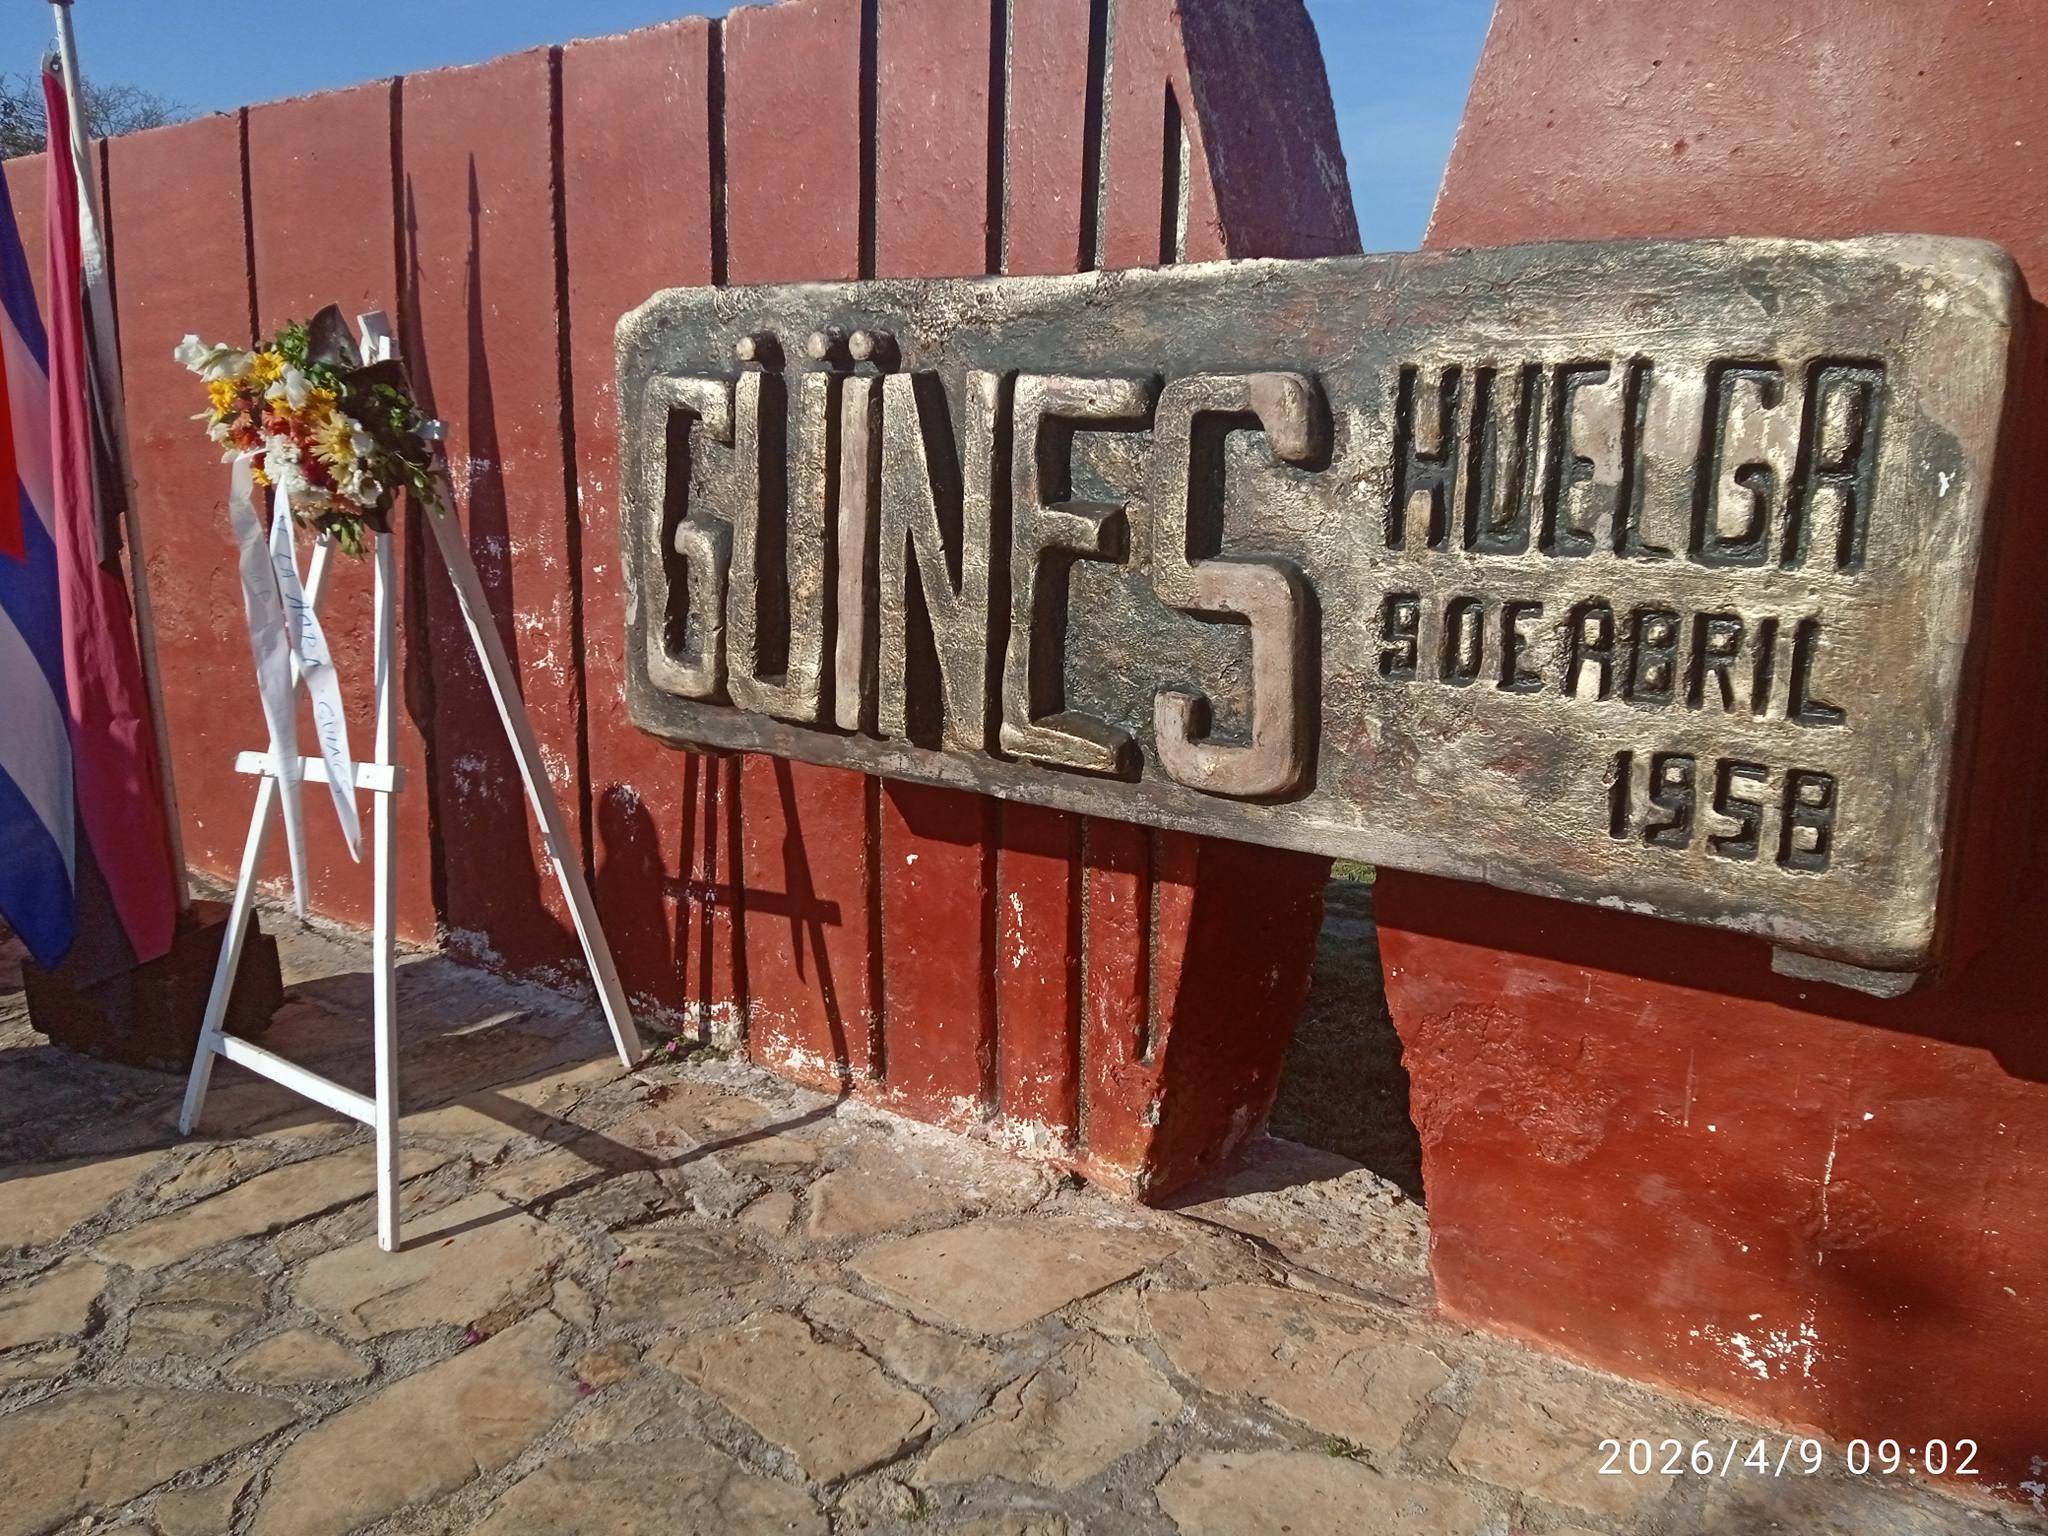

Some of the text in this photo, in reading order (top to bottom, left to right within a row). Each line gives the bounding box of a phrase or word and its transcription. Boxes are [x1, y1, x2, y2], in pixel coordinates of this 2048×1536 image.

[1385, 355, 1887, 570] HUELGA
[1378, 591, 1421, 679] 9
[1565, 595, 1847, 727] ABRIL
[1607, 748, 1839, 873] 1958
